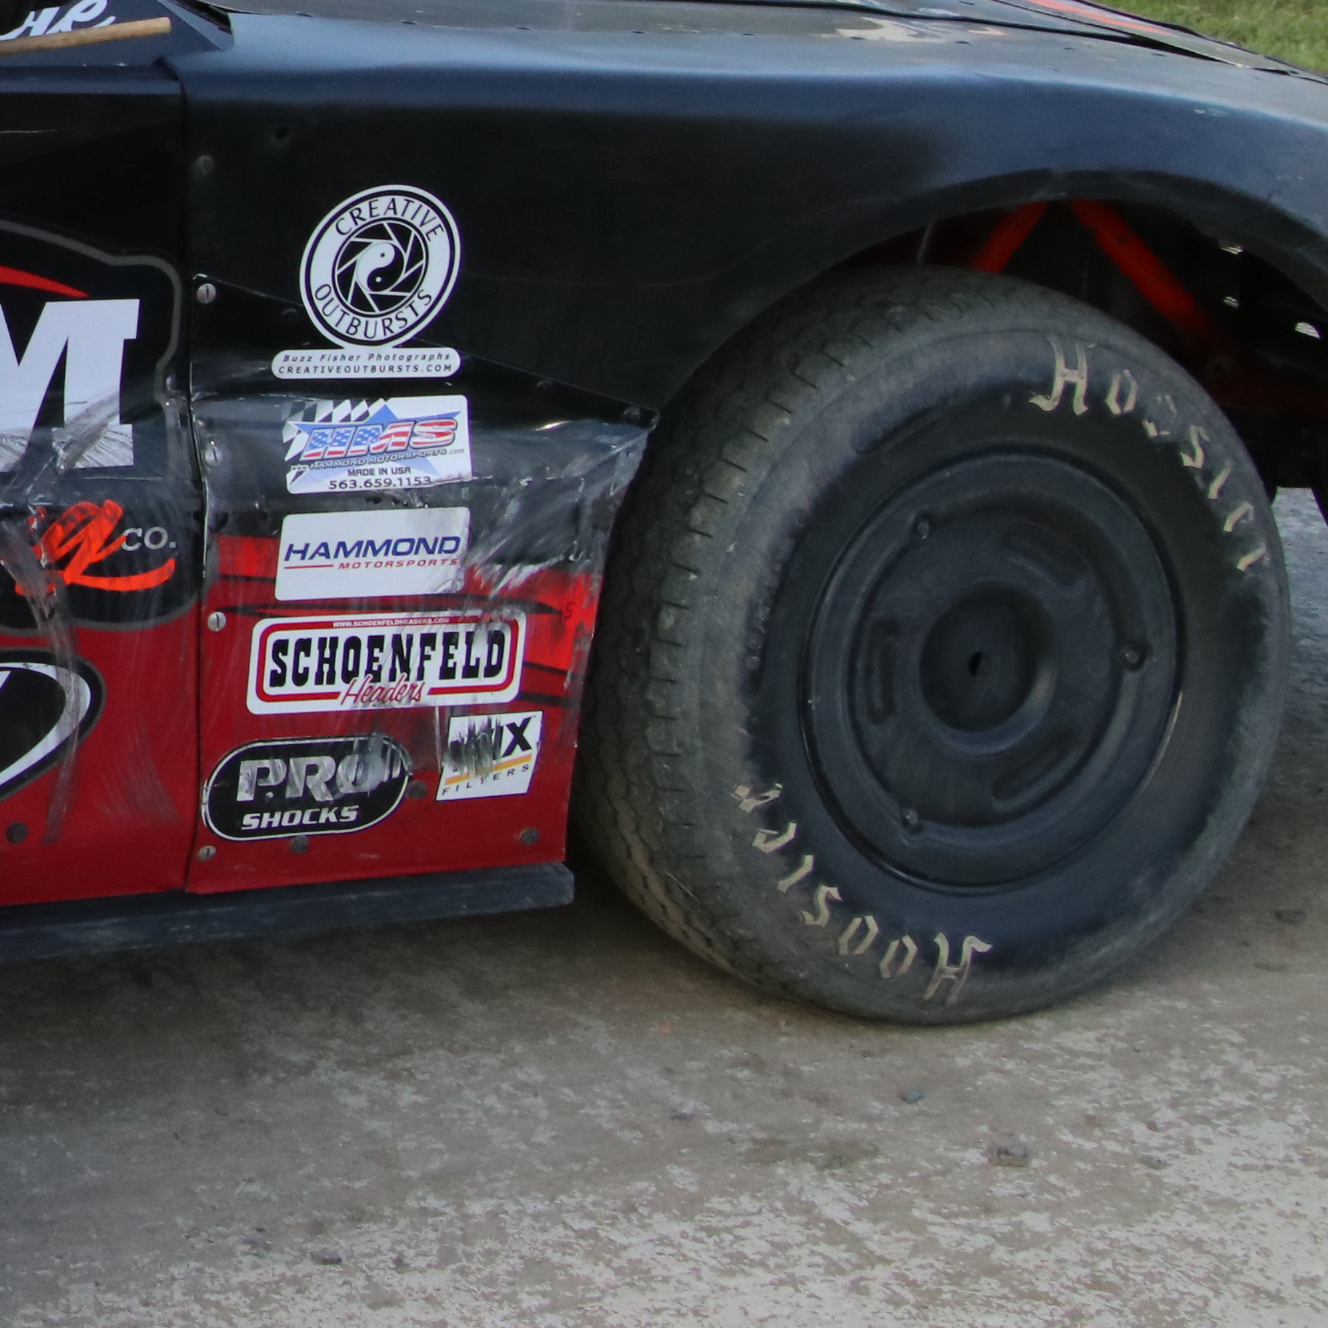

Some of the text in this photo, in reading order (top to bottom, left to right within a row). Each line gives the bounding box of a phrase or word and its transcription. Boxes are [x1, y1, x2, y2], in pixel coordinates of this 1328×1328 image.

[333, 195, 445, 243] CREATIVE
[314, 282, 434, 340] OUTBURSTS
[278, 363, 452, 374] CREATIVEOUTBURSTS.COM
[282, 352, 451, 363] Buzz Fisher Photographs
[299, 417, 459, 463] HMS
[328, 475, 433, 490] 563.659.1153
[347, 468, 376, 477] MADE
[390, 466, 412, 475] USA
[121, 524, 177, 552] CO.
[284, 535, 462, 562] HAMMOND
[338, 558, 460, 571] MOTORSPORTS
[332, 616, 451, 628] WWW.SCHOENFELDHEADERS.COM
[268, 628, 507, 690] SCHOENFELD
[339, 673, 428, 707] Headers
[441, 762, 531, 797] FILTERS
[240, 803, 360, 831] SHOCKS
